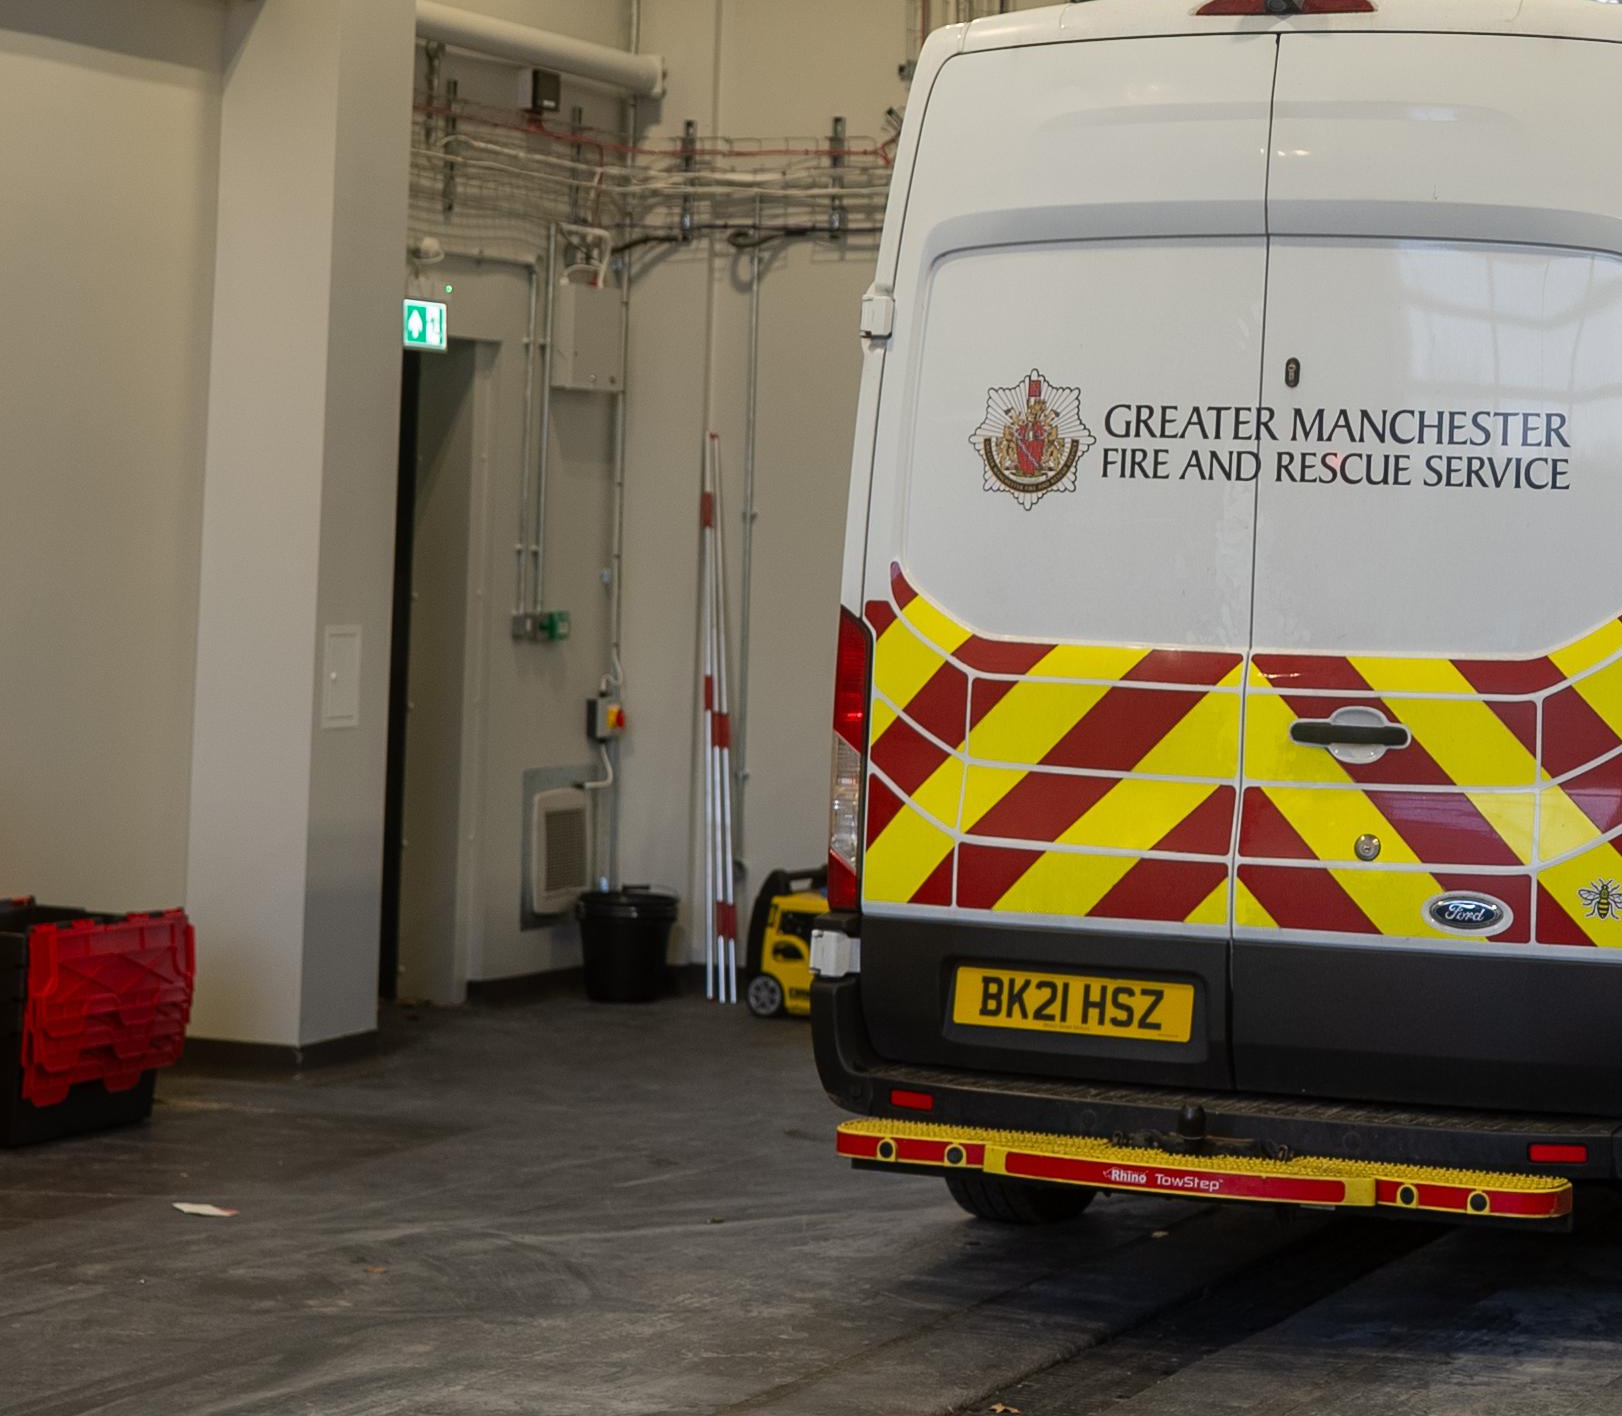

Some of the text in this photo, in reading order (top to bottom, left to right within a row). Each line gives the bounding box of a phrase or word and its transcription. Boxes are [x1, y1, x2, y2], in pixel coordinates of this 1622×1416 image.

[1104, 404, 1571, 448] GREATER MANCHESTER
[1101, 448, 1170, 480] FIRE
[1179, 450, 1261, 482] AND
[1275, 451, 1412, 487] RESCUE
[1423, 455, 1571, 490] SERVICE
[1445, 903, 1486, 921] Ford
[979, 975, 1165, 1031] BK21 HSZ
[1111, 1169, 1147, 1184] Rhino
